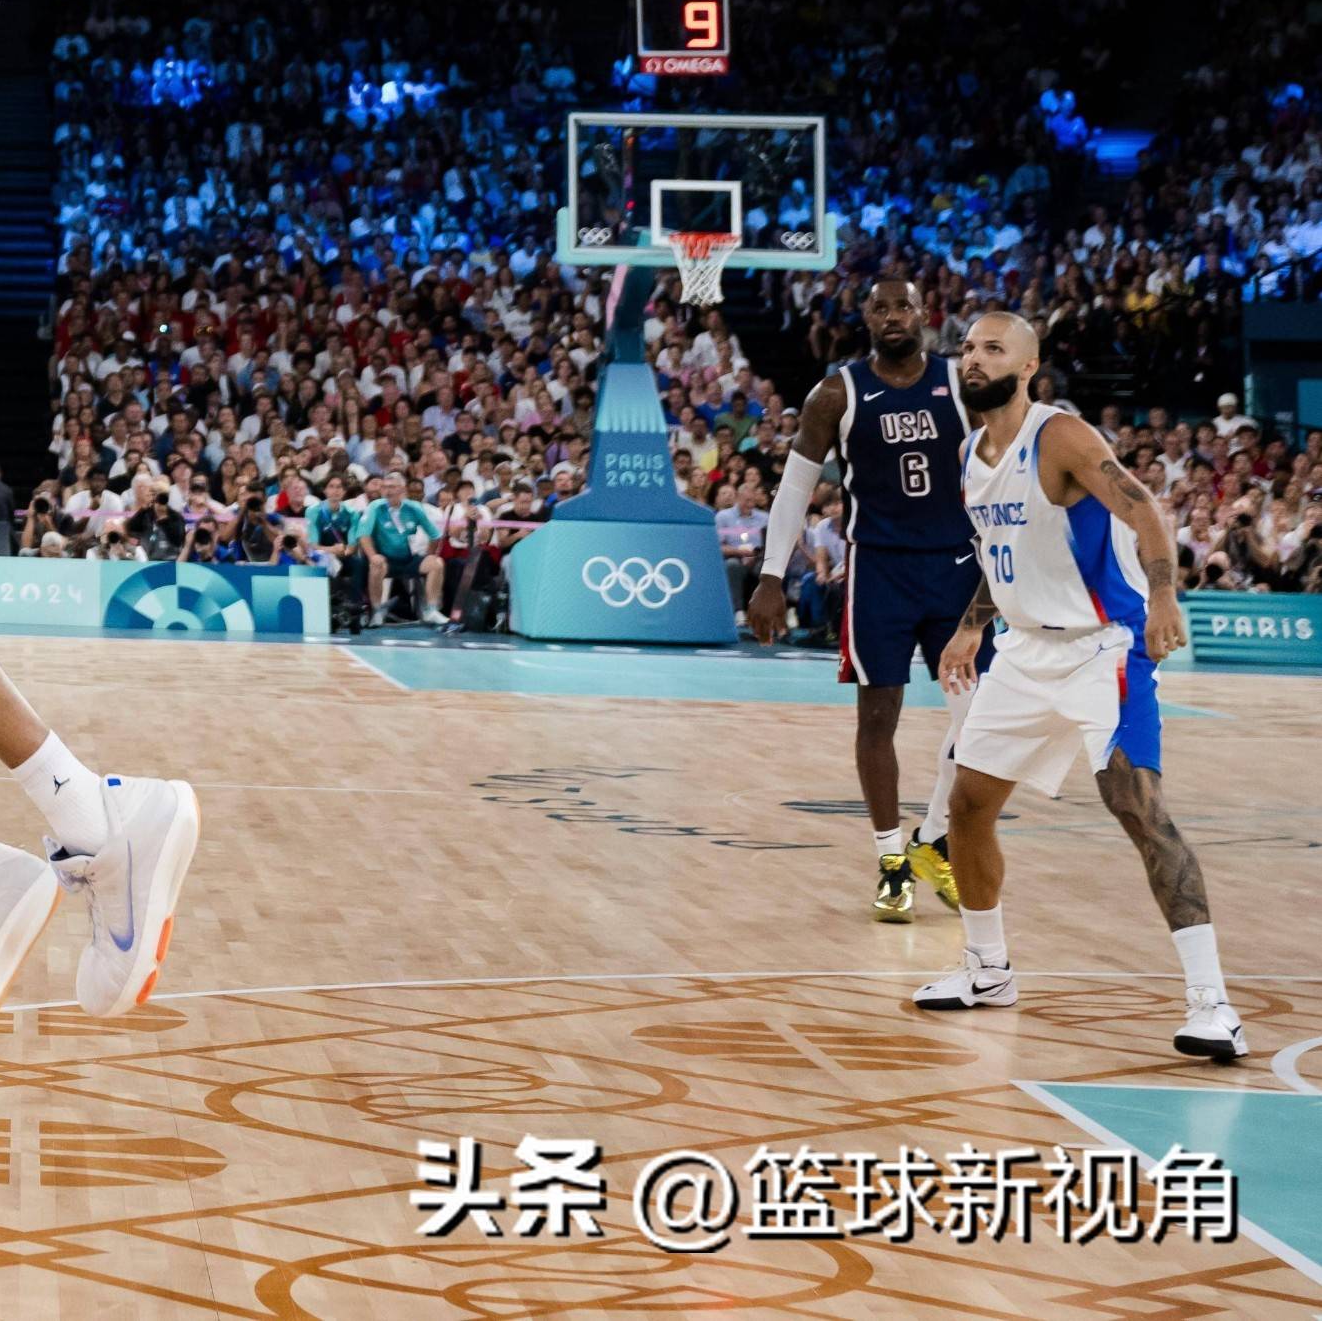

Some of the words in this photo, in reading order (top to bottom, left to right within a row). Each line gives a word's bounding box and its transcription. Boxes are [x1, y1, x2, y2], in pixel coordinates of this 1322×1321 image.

[684, 1, 718, 48] 9
[663, 58, 724, 74] OMEGA
[879, 408, 939, 444] USA
[604, 453, 665, 470] PARIS
[899, 451, 932, 497] 6
[605, 470, 666, 488] 2024
[988, 544, 1015, 584] 10
[0, 582, 83, 604] 2024
